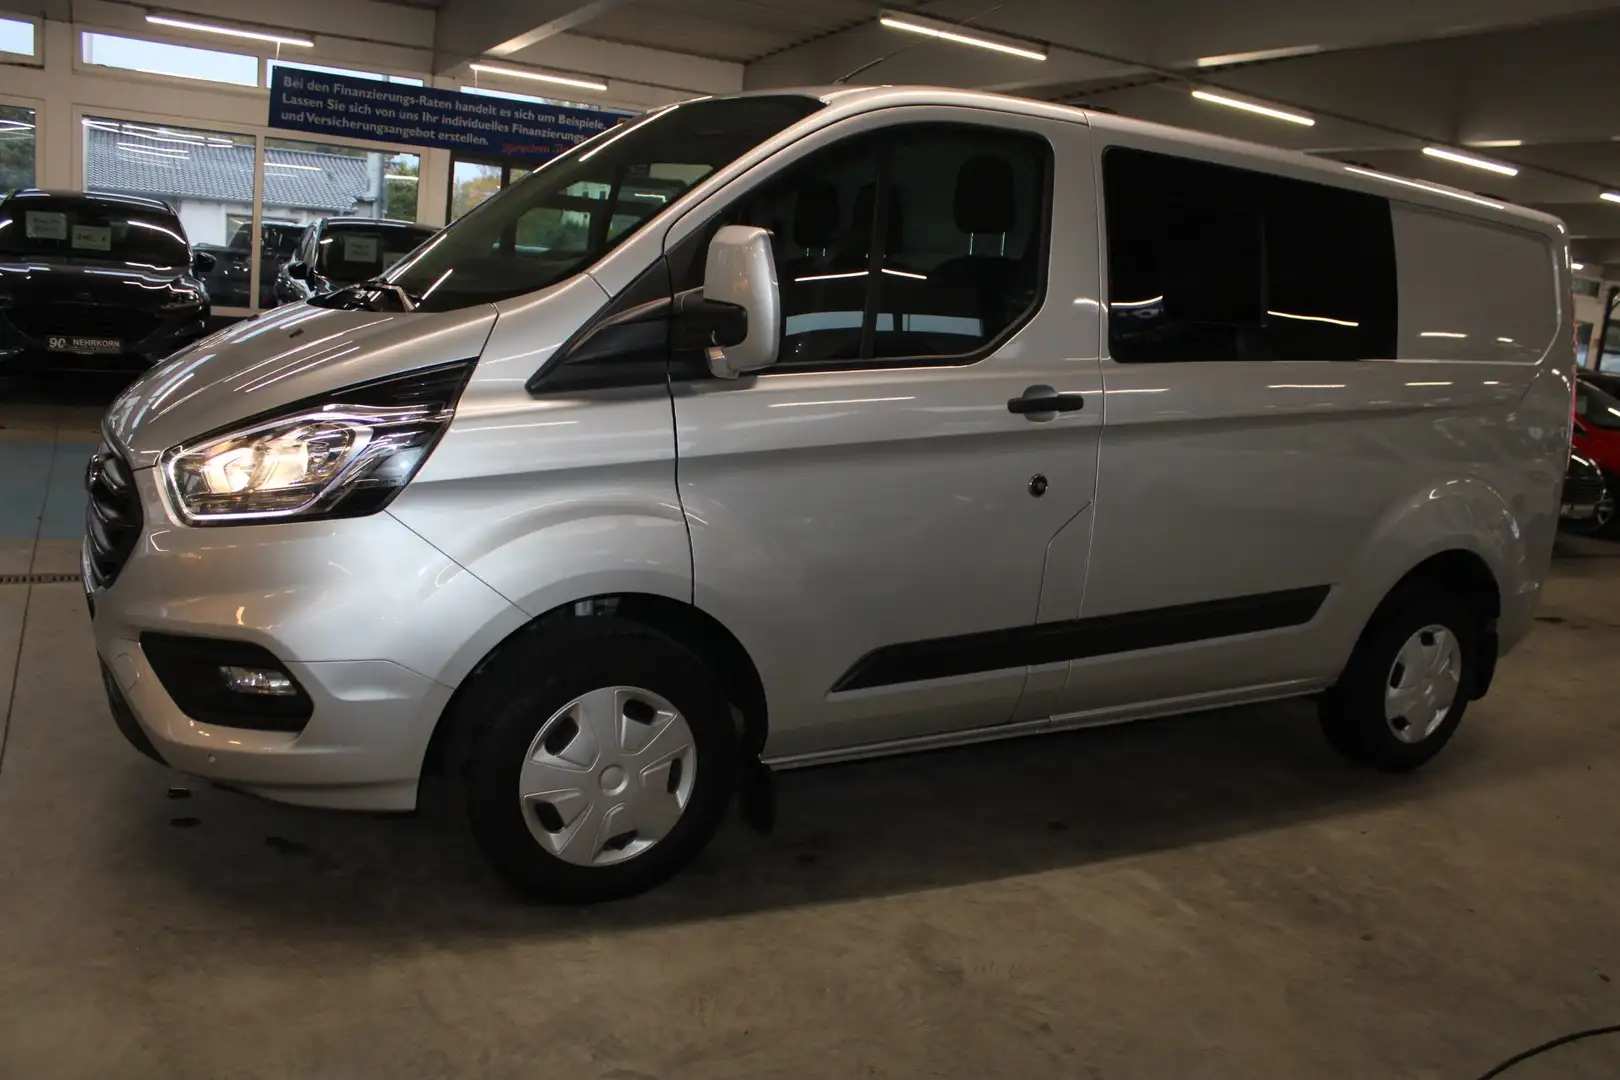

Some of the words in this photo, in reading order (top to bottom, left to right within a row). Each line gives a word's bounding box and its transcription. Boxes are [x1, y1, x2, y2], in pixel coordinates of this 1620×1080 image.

[282, 92, 324, 109] Lassen
[327, 97, 346, 112] Sie
[348, 100, 372, 116] sich
[375, 107, 396, 119] von
[399, 109, 419, 122] uns
[422, 112, 440, 125] Ihr
[442, 115, 509, 133] individuelles
[283, 76, 304, 89] Bei
[307, 80, 330, 94] den
[333, 83, 451, 109] Finanzierungs-Raten
[455, 101, 497, 116] handelt
[500, 108, 512, 118] es
[514, 108, 535, 121] sich
[537, 114, 556, 124] um
[281, 110, 304, 123] und
[306, 112, 436, 139] Versicherungsangebot
[438, 129, 490, 146] erstellen.
[73, 339, 120, 348] NEHRKORN
